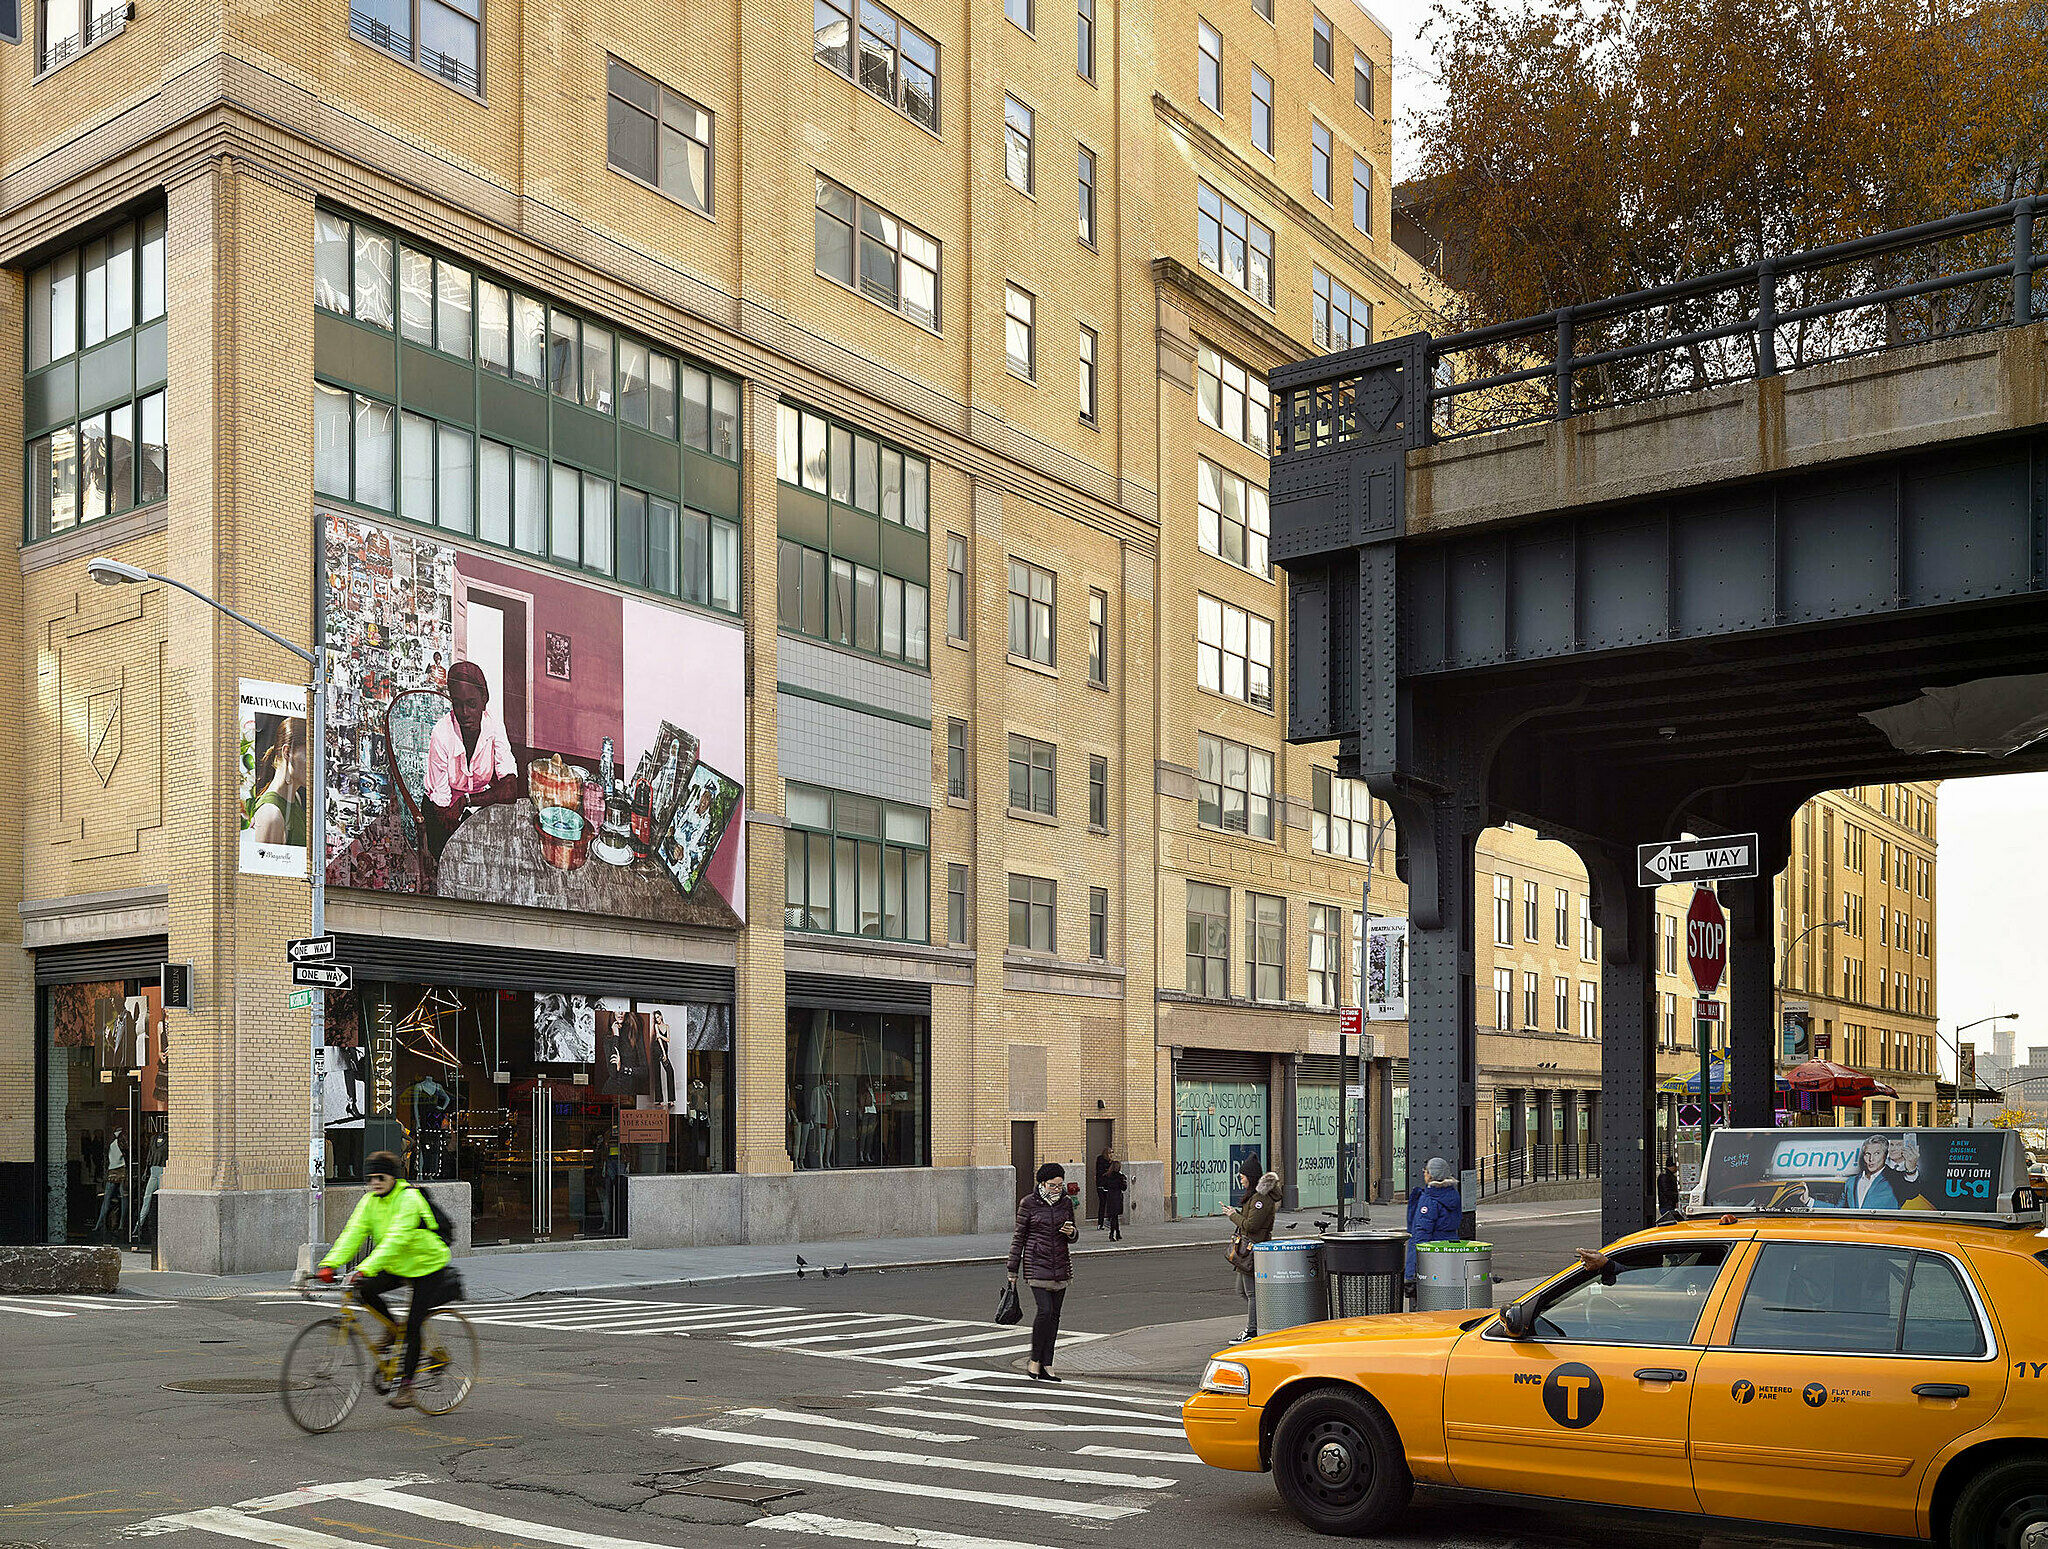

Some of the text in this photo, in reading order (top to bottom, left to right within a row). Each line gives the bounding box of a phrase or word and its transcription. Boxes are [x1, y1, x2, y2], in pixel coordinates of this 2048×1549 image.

[240, 694, 306, 712] MEATPACKING
[1656, 848, 1741, 872] ONE WAY
[1689, 919, 1724, 960] STOP
[294, 943, 329, 956] ONE WAY
[301, 969, 344, 982] ONE WAY
[1698, 1003, 1719, 1017] ALL WAY
[375, 1003, 393, 1115] INTERMIX
[1203, 1092, 1262, 1109] GANSEVOORT
[1219, 1115, 1262, 1138] SPACE
[1776, 1147, 1861, 1172] donny!
[1946, 1168, 1992, 1178] NOV 10TH
[1513, 1373, 1590, 1420] NYC T
[1758, 1386, 1793, 1394] METERED
[1831, 1388, 1849, 1396] FLAT
[1831, 1396, 1846, 1404] JFK
